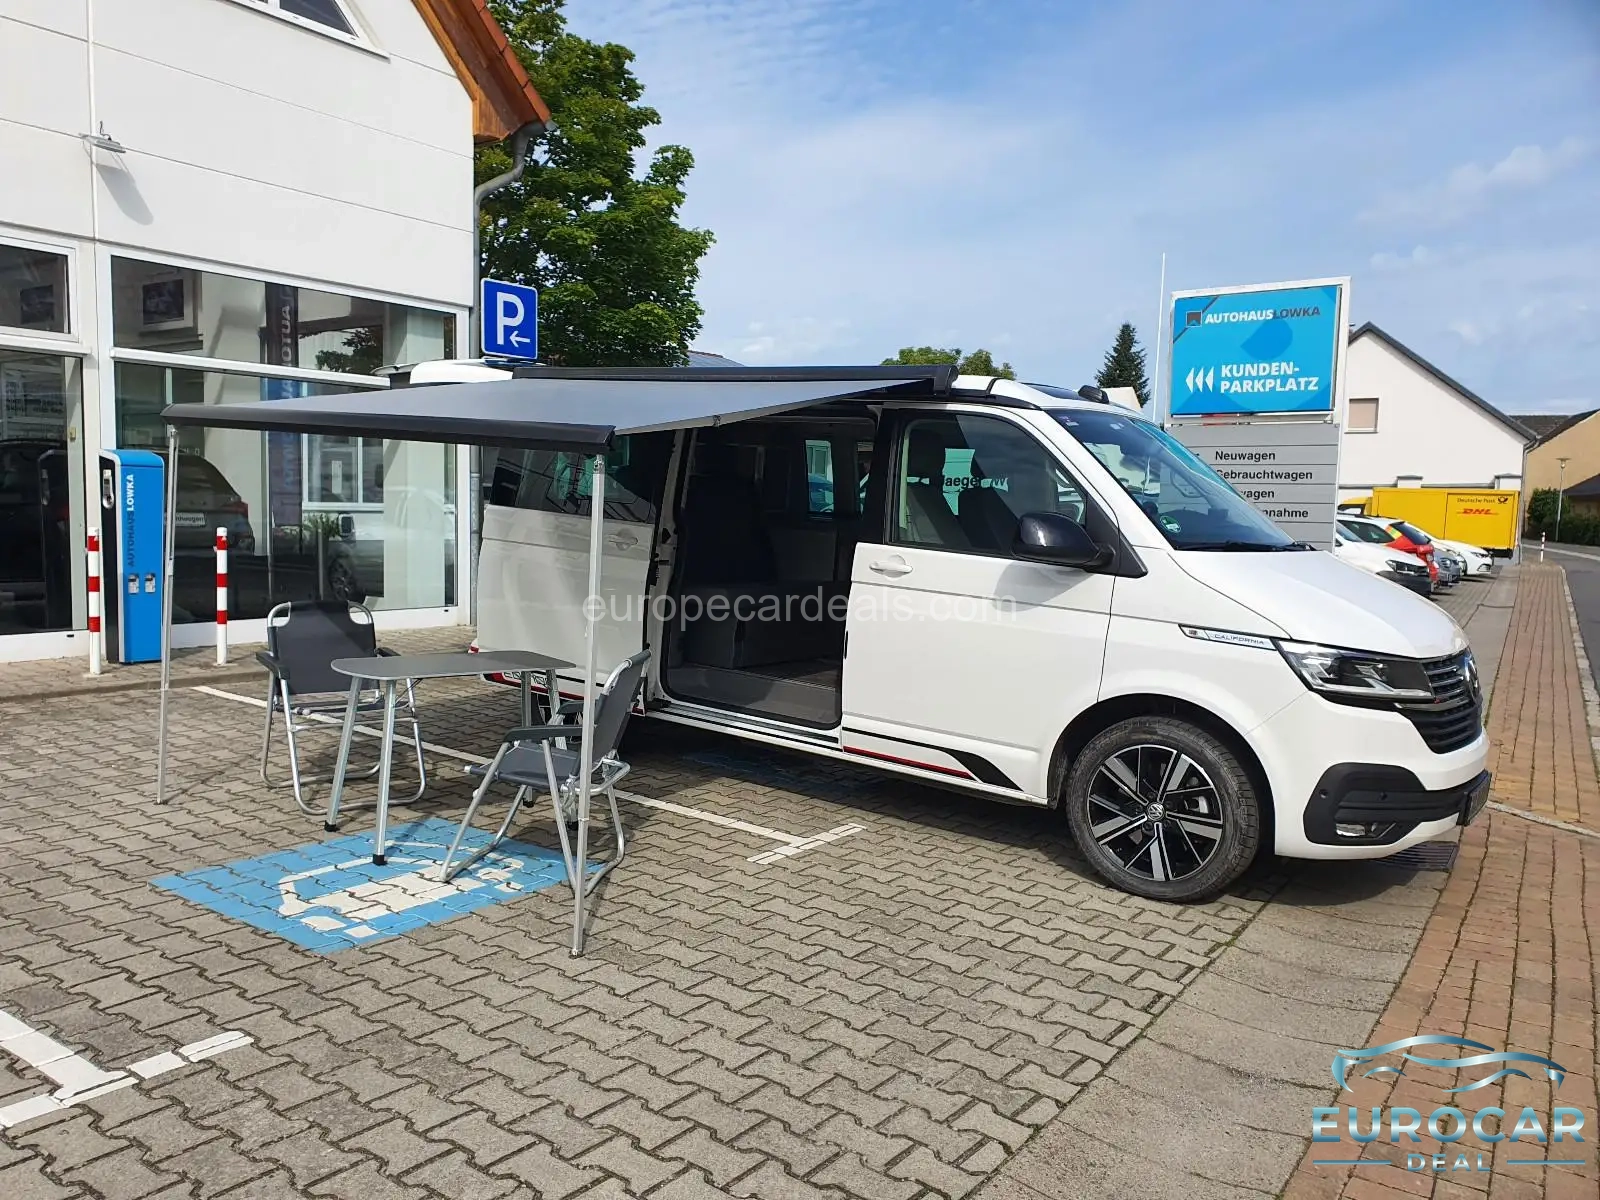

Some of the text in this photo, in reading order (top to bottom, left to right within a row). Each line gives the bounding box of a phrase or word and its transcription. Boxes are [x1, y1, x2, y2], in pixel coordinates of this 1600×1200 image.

[497, 291, 525, 346] P
[1220, 361, 1300, 378] KUNDEN-
[1220, 376, 1320, 394] PARKPLATZ
[1215, 450, 1276, 462] Neuwagen
[1214, 633, 1265, 645] CALIFORNIA
